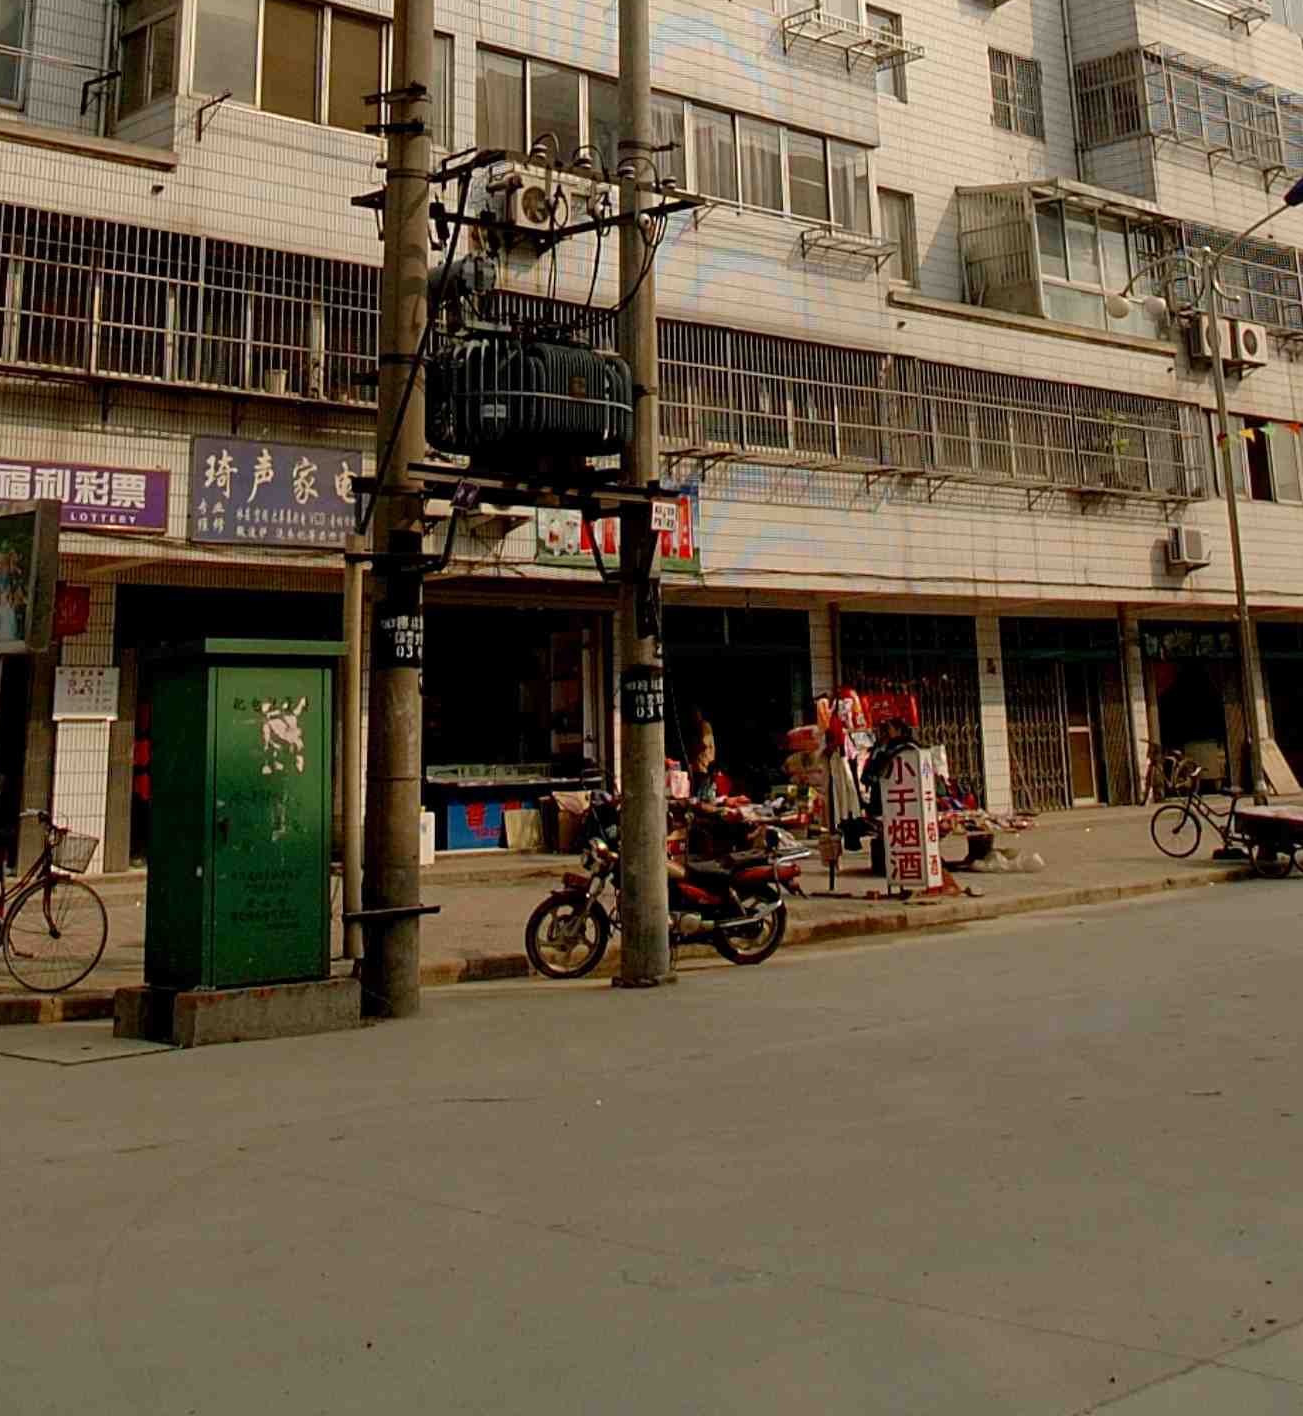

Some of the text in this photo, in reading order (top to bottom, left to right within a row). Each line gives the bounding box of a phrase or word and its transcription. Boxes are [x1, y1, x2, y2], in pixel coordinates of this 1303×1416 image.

[204, 448, 358, 505] 琦声家电
[70, 511, 138, 525] LOTTERY
[884, 756, 923, 880] 小于烟酒
